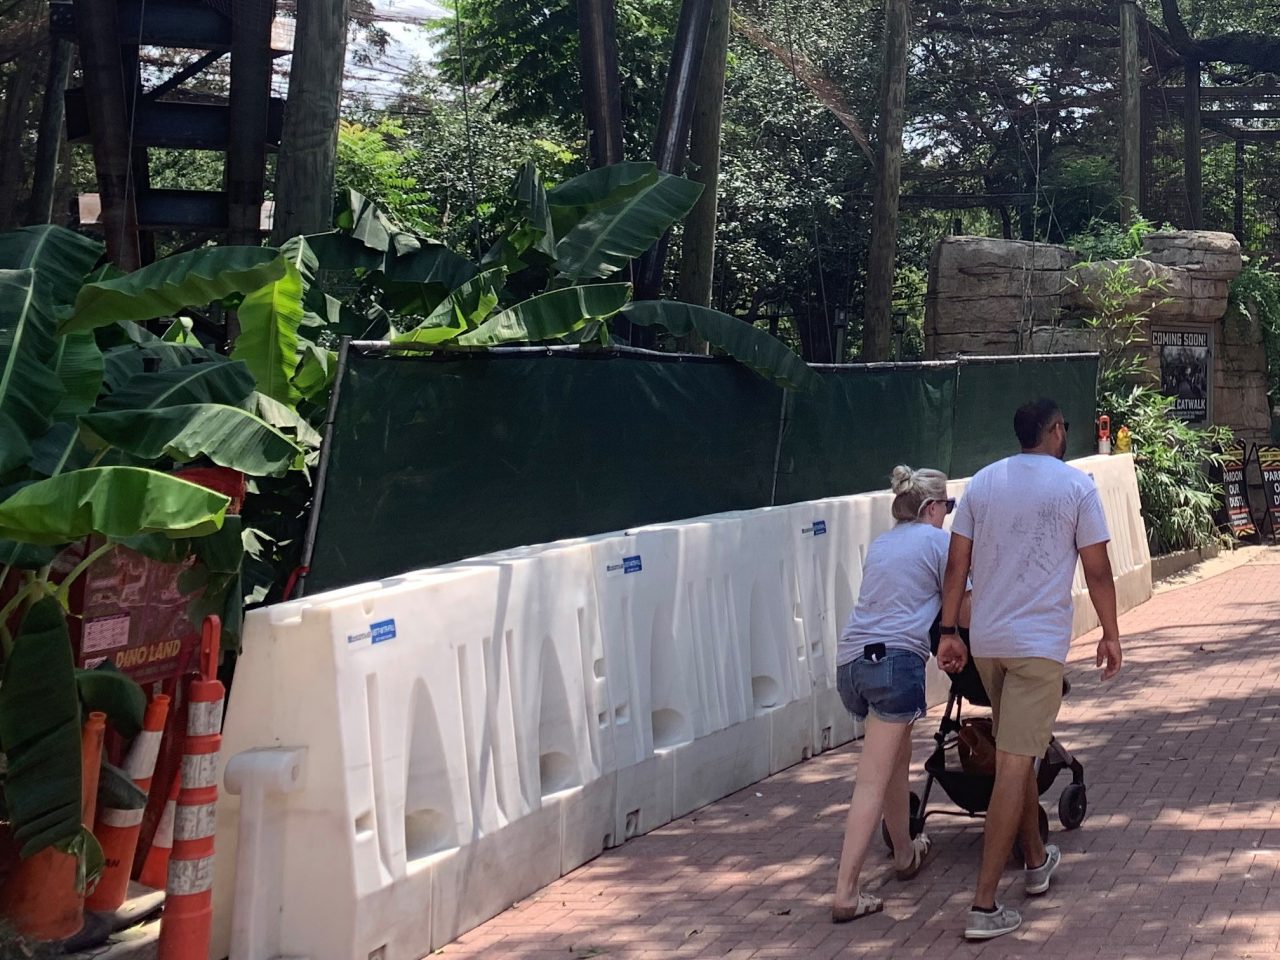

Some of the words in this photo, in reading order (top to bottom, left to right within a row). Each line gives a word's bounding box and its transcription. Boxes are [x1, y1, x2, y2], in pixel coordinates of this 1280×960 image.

[1152, 332, 1182, 345] COMING
[1183, 333, 1206, 346] SOON!
[1177, 399, 1206, 410] CATWALK
[1223, 471, 1243, 482] PARDON
[1229, 484, 1240, 495] OUR
[115, 646, 148, 668] DINO
[149, 640, 181, 661] LAND
